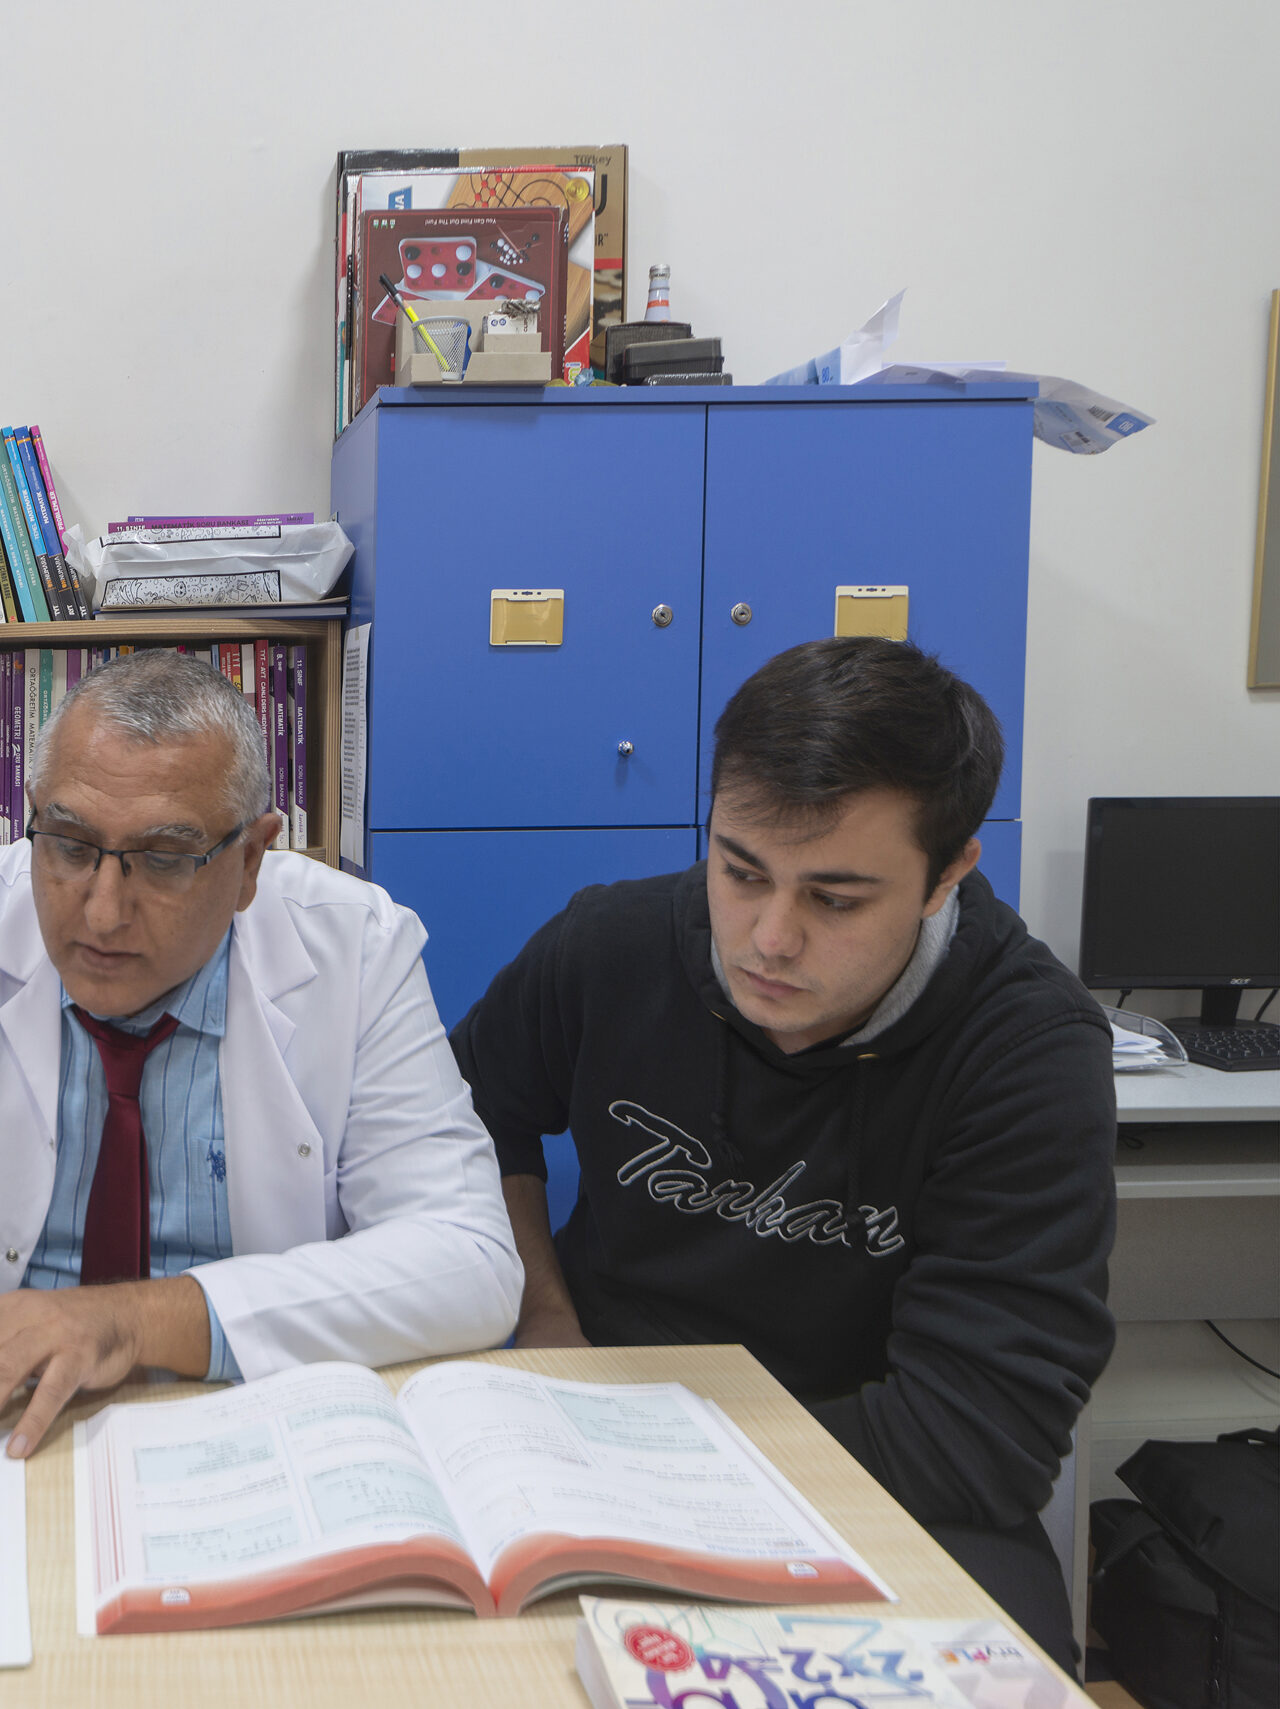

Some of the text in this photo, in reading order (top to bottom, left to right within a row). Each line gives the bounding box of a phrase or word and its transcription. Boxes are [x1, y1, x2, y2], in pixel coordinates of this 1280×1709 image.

[36, 490, 50, 525] MATEMATİK
[50, 490, 64, 532] PROBLEMLER
[196, 520, 216, 528] SORU
[216, 518, 250, 528] BANKASI
[28, 667, 36, 718] ORTAÖĞRETİM
[608, 1099, 906, 1258] Tarhan
